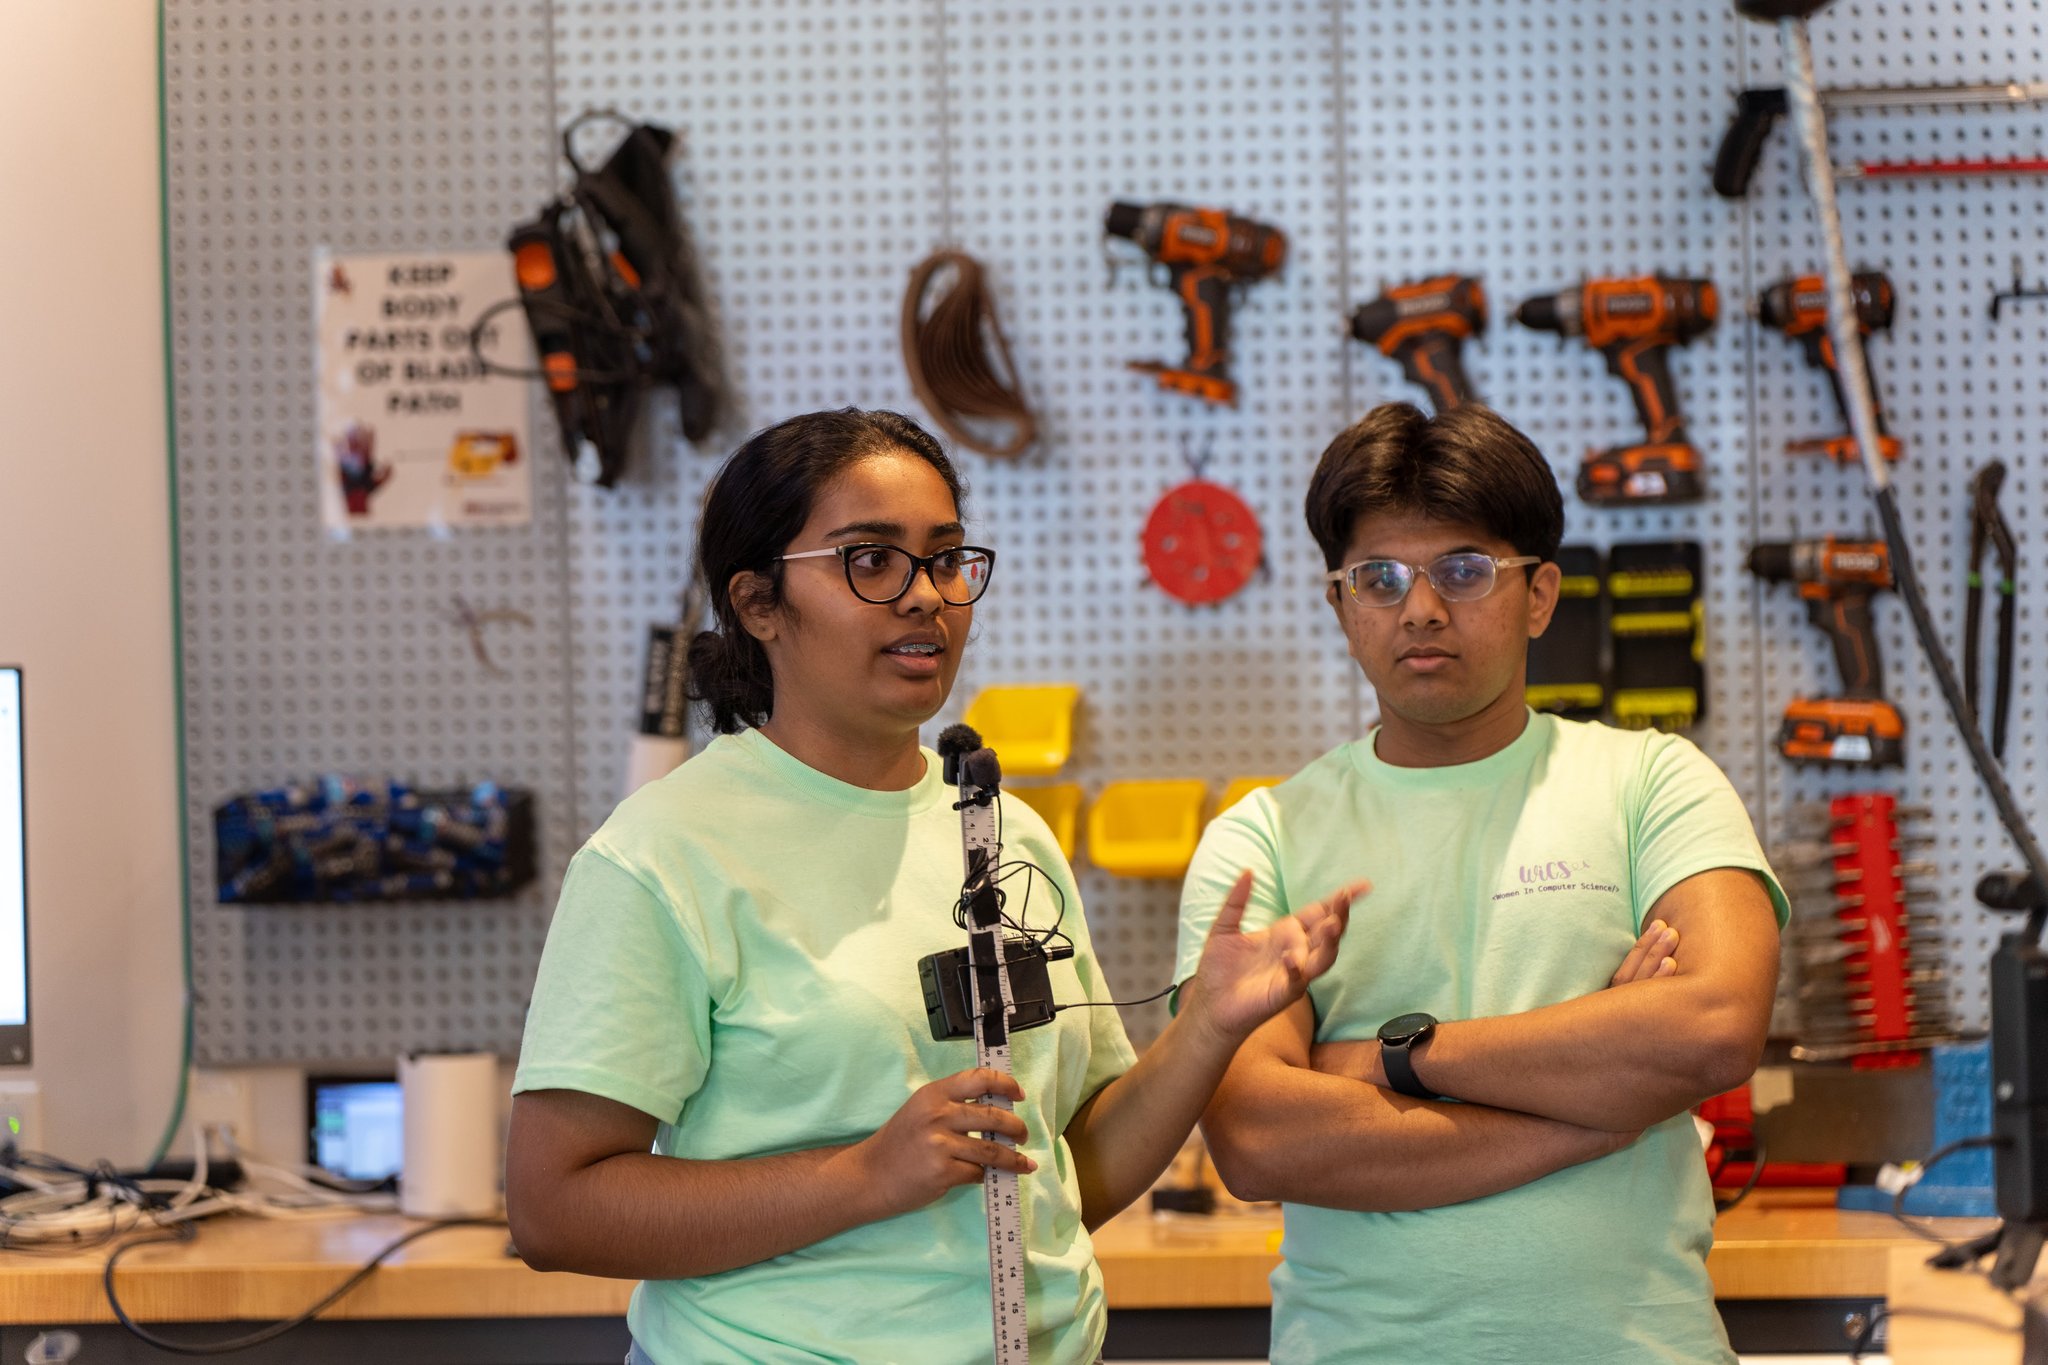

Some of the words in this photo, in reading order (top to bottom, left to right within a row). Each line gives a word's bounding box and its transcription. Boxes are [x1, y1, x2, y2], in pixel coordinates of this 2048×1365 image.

[388, 264, 453, 284] KEEP
[381, 294, 460, 318] BODY
[345, 328, 430, 350] PARTS
[356, 359, 391, 385] OF
[1524, 887, 1534, 895] In
[1538, 882, 1576, 892] Computer
[1005, 1194, 1013, 1207] 12
[1007, 1230, 1015, 1242] 13
[1009, 1266, 1017, 1278] 14
[1012, 1302, 1019, 1314] 15
[1014, 1338, 1021, 1350] 16
